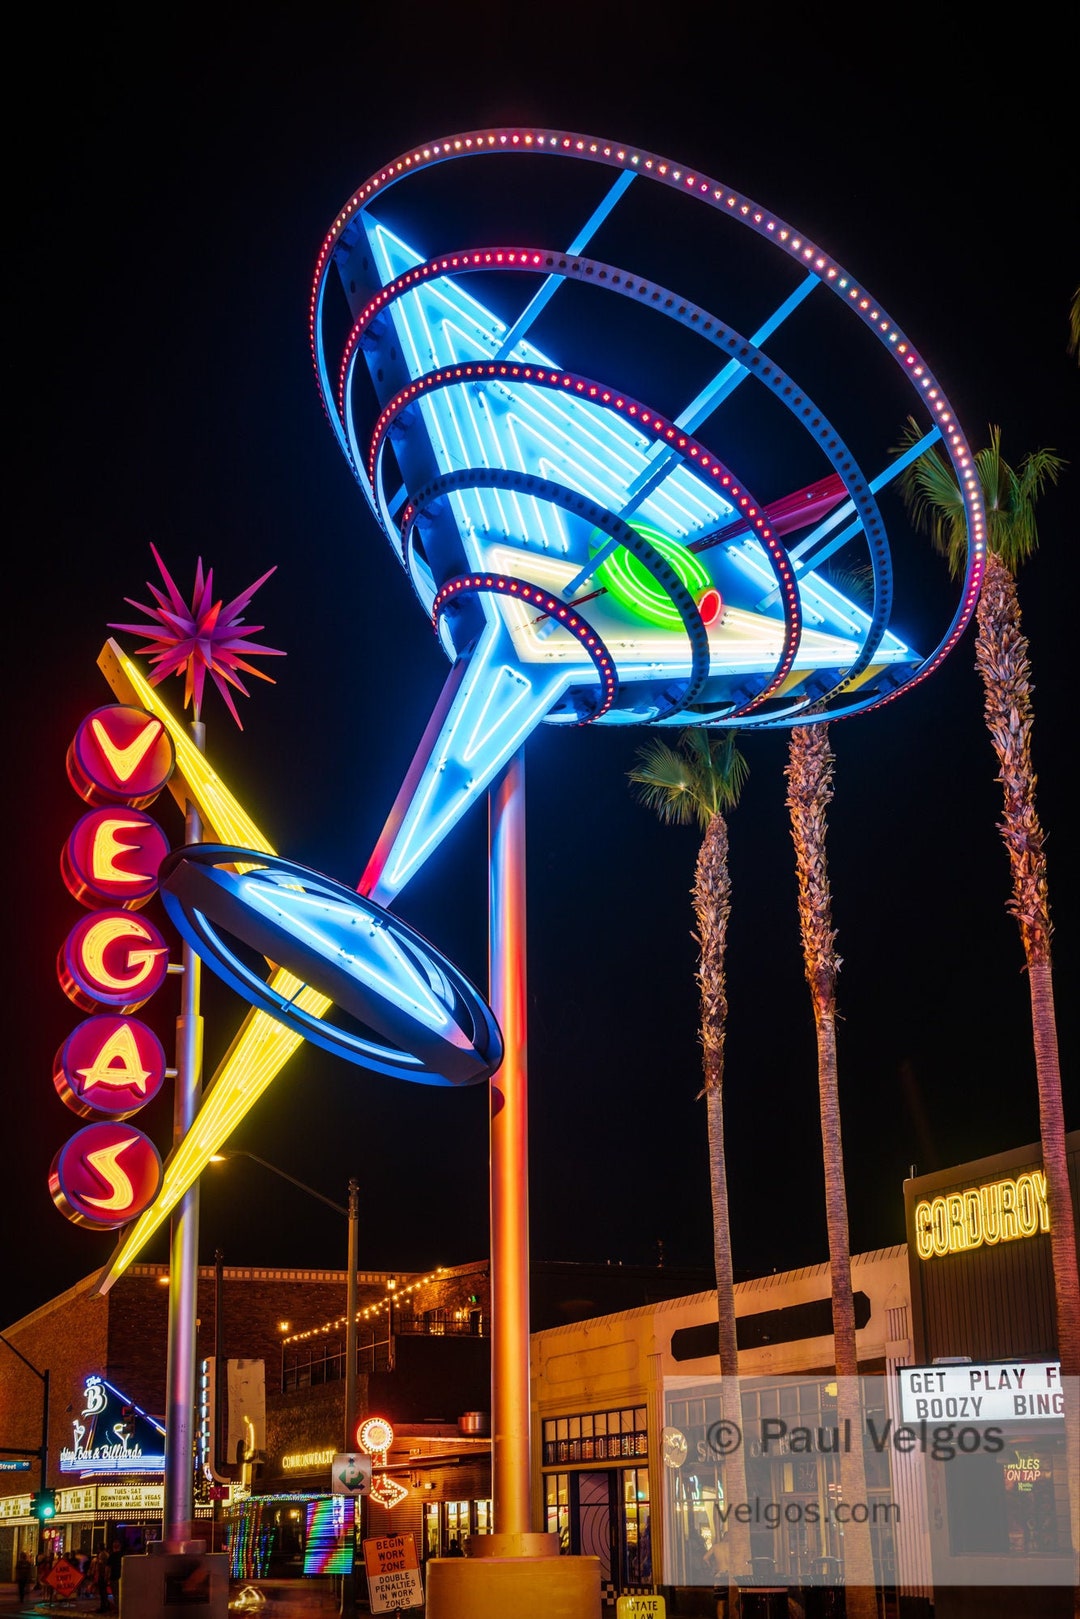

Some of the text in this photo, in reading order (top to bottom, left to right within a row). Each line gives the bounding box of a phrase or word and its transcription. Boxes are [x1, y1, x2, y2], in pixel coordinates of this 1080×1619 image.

[76, 718, 168, 1210] VEGAS
[914, 1170, 1050, 1260] CORDUROY
[910, 1372, 946, 1394] GET
[969, 1368, 1026, 1391] PLAY
[916, 1396, 983, 1419] BOOZY
[1006, 1470, 1041, 1481] ON TAP
[376, 1538, 404, 1550] BEGIN
[378, 1549, 405, 1560] WORK
[381, 1560, 406, 1573] ZONE
[379, 1572, 410, 1584] DOUBLE
[375, 1580, 416, 1593] PENALTIES
[391, 1588, 414, 1599] WORK
[385, 1598, 411, 1608] ZONES
[630, 1601, 658, 1611] STATE
